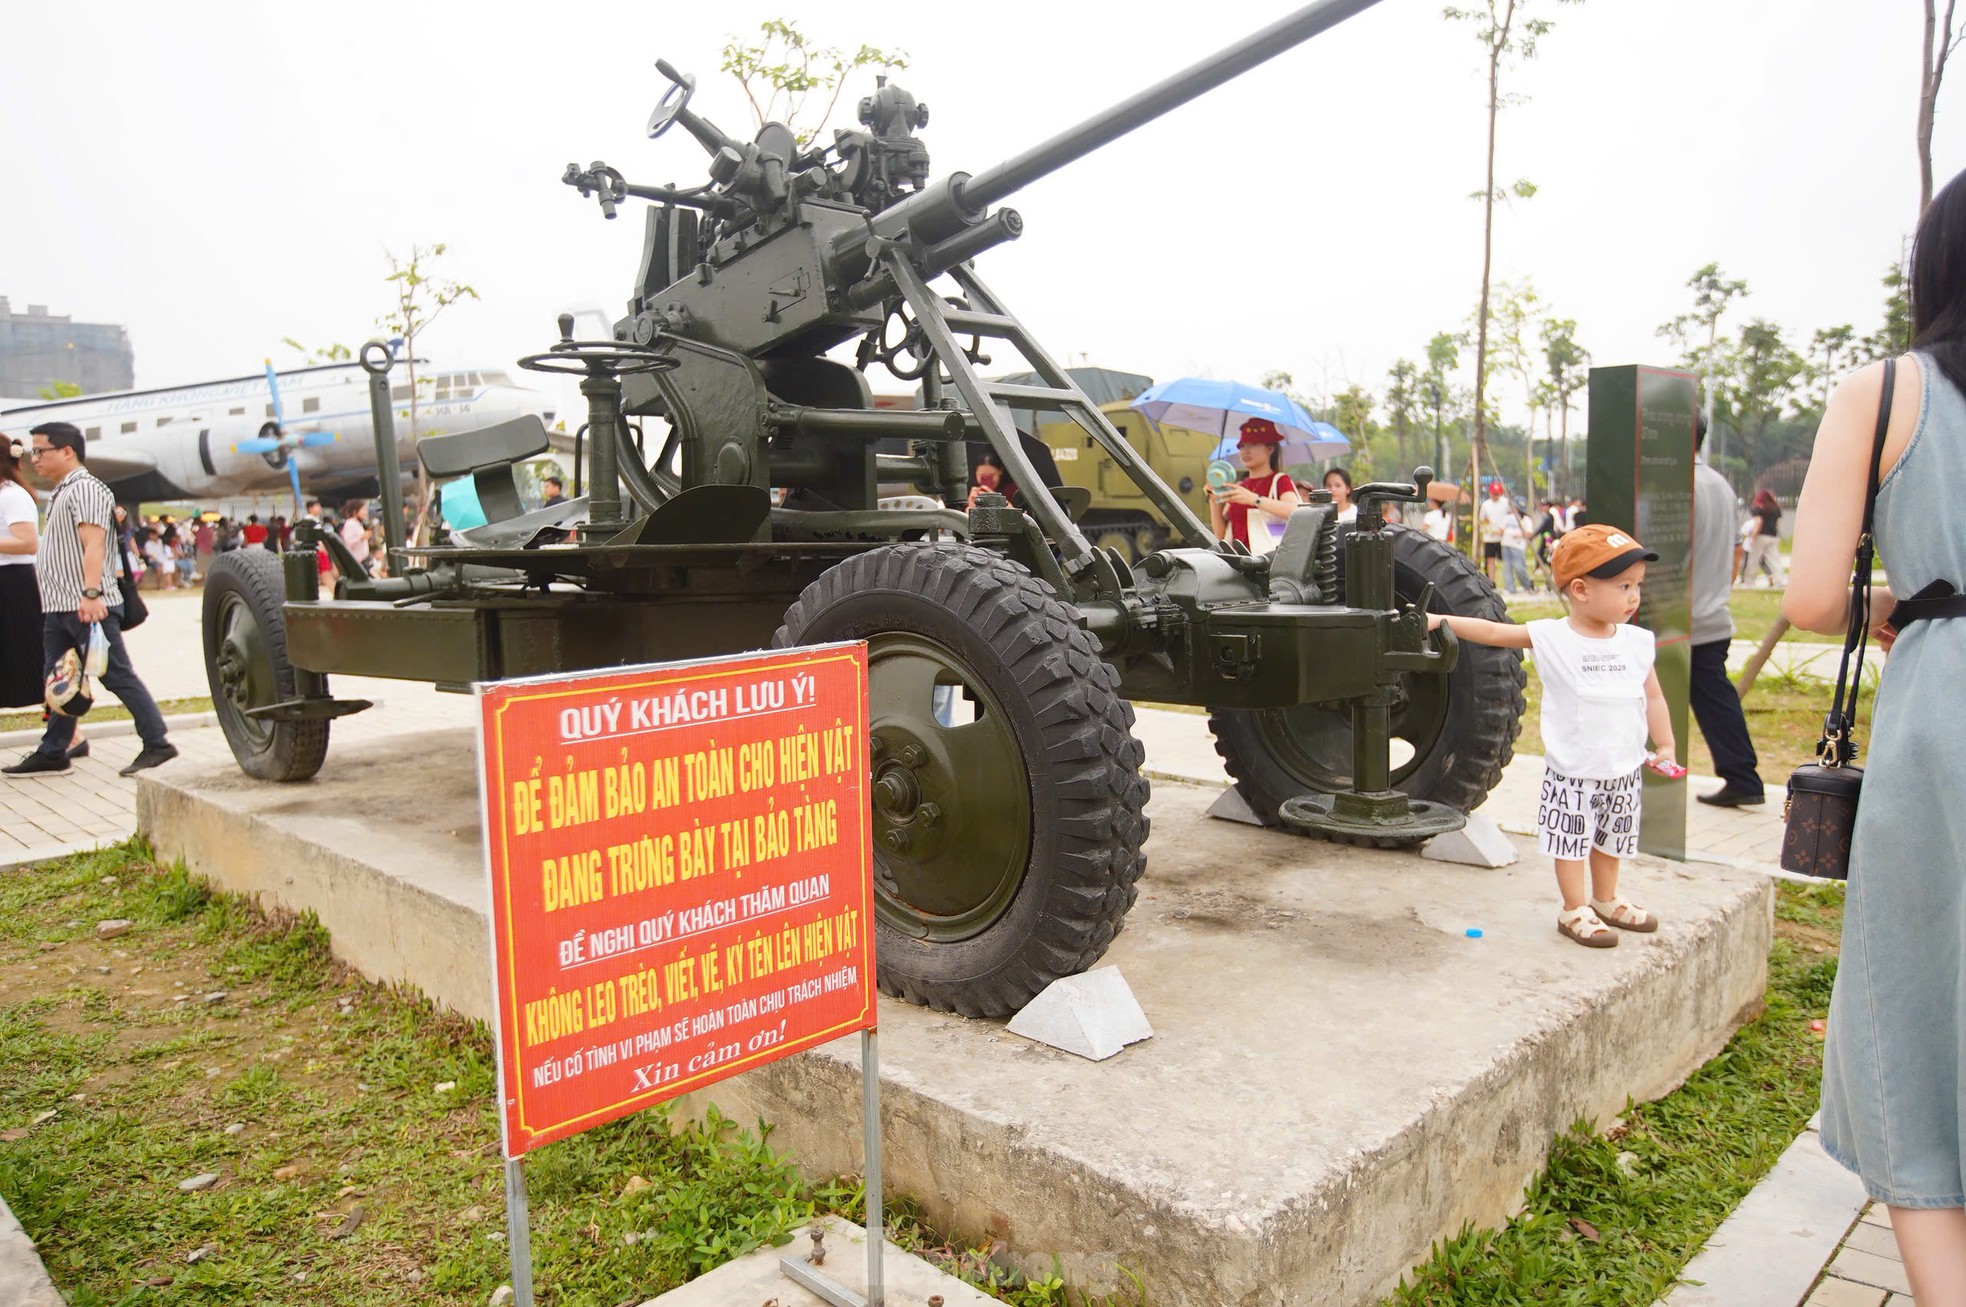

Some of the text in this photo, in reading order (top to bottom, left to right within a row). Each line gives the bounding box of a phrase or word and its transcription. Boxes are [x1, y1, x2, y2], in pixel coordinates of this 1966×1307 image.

[560, 671, 816, 740] QUÝ KHÁCH LƯU Ý!
[513, 717, 854, 836] ĐỂ ĐẢM BẢO AN TOÀN CHO HIỆN VẬT
[543, 794, 837, 913] ĐANG TRƯNG BÀY TẠI BẢO TÀNG
[1546, 832, 1590, 857] TIME
[559, 873, 830, 966] ĐỀ NGHỊ QUÝ KHÁCH THĂM QUAN
[525, 905, 858, 1047] KHÔNG LEO TRÈO, VIẾT, VẼ, KÝ TÊN LÊN HIỆN VẬT
[533, 966, 858, 1088] NẾU CỐ TÌNH VI PHẠM SẼ HOÀN TOÀN CHỊU TRÁCH NHIỆM
[631, 1020, 788, 1093] Xin cảm ơn!
